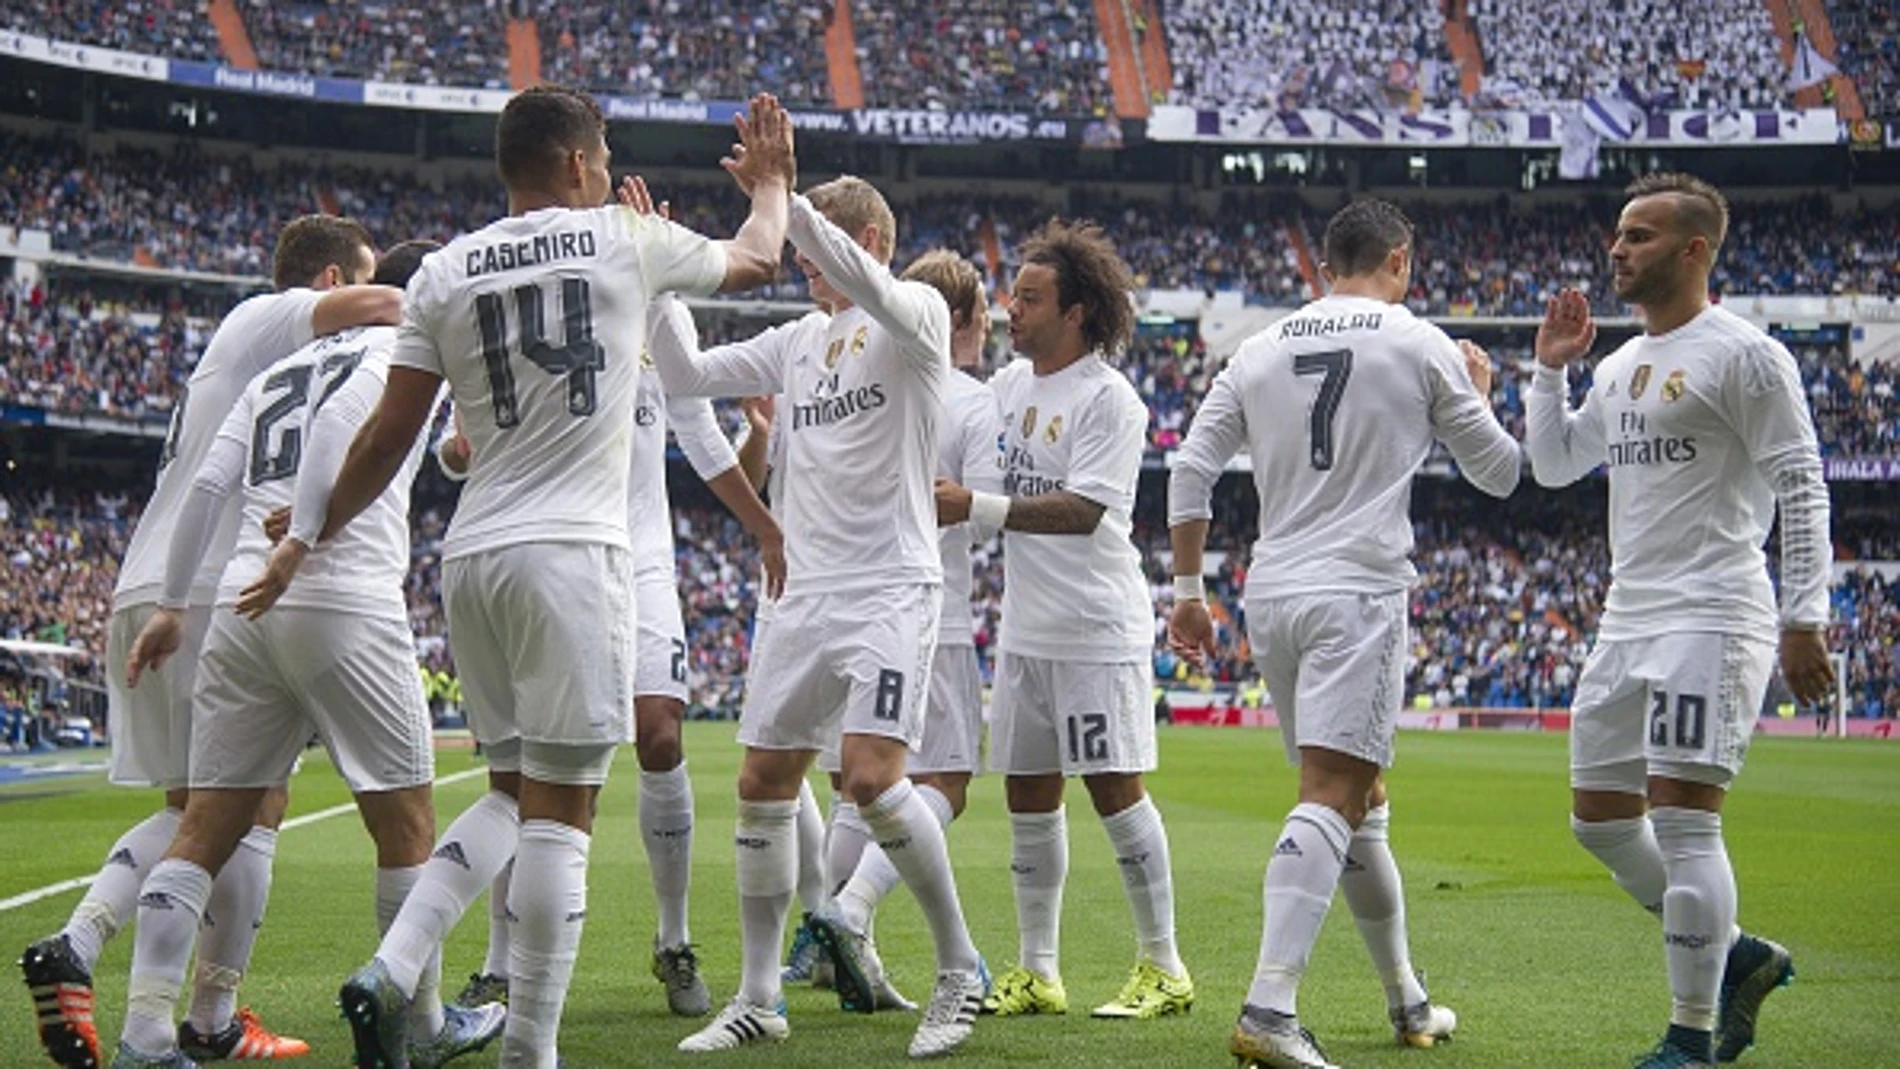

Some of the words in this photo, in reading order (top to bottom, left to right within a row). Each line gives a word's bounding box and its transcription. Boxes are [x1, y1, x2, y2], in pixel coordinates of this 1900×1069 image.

[852, 109, 1030, 140] VETERANOS
[466, 230, 597, 278] CASEMIRO
[1279, 312, 1383, 341] RONALDO
[475, 277, 606, 429] 14
[1293, 348, 1354, 471] 7
[873, 668, 904, 723] 8
[1649, 690, 1707, 750] 20
[1066, 713, 1109, 762] 12
